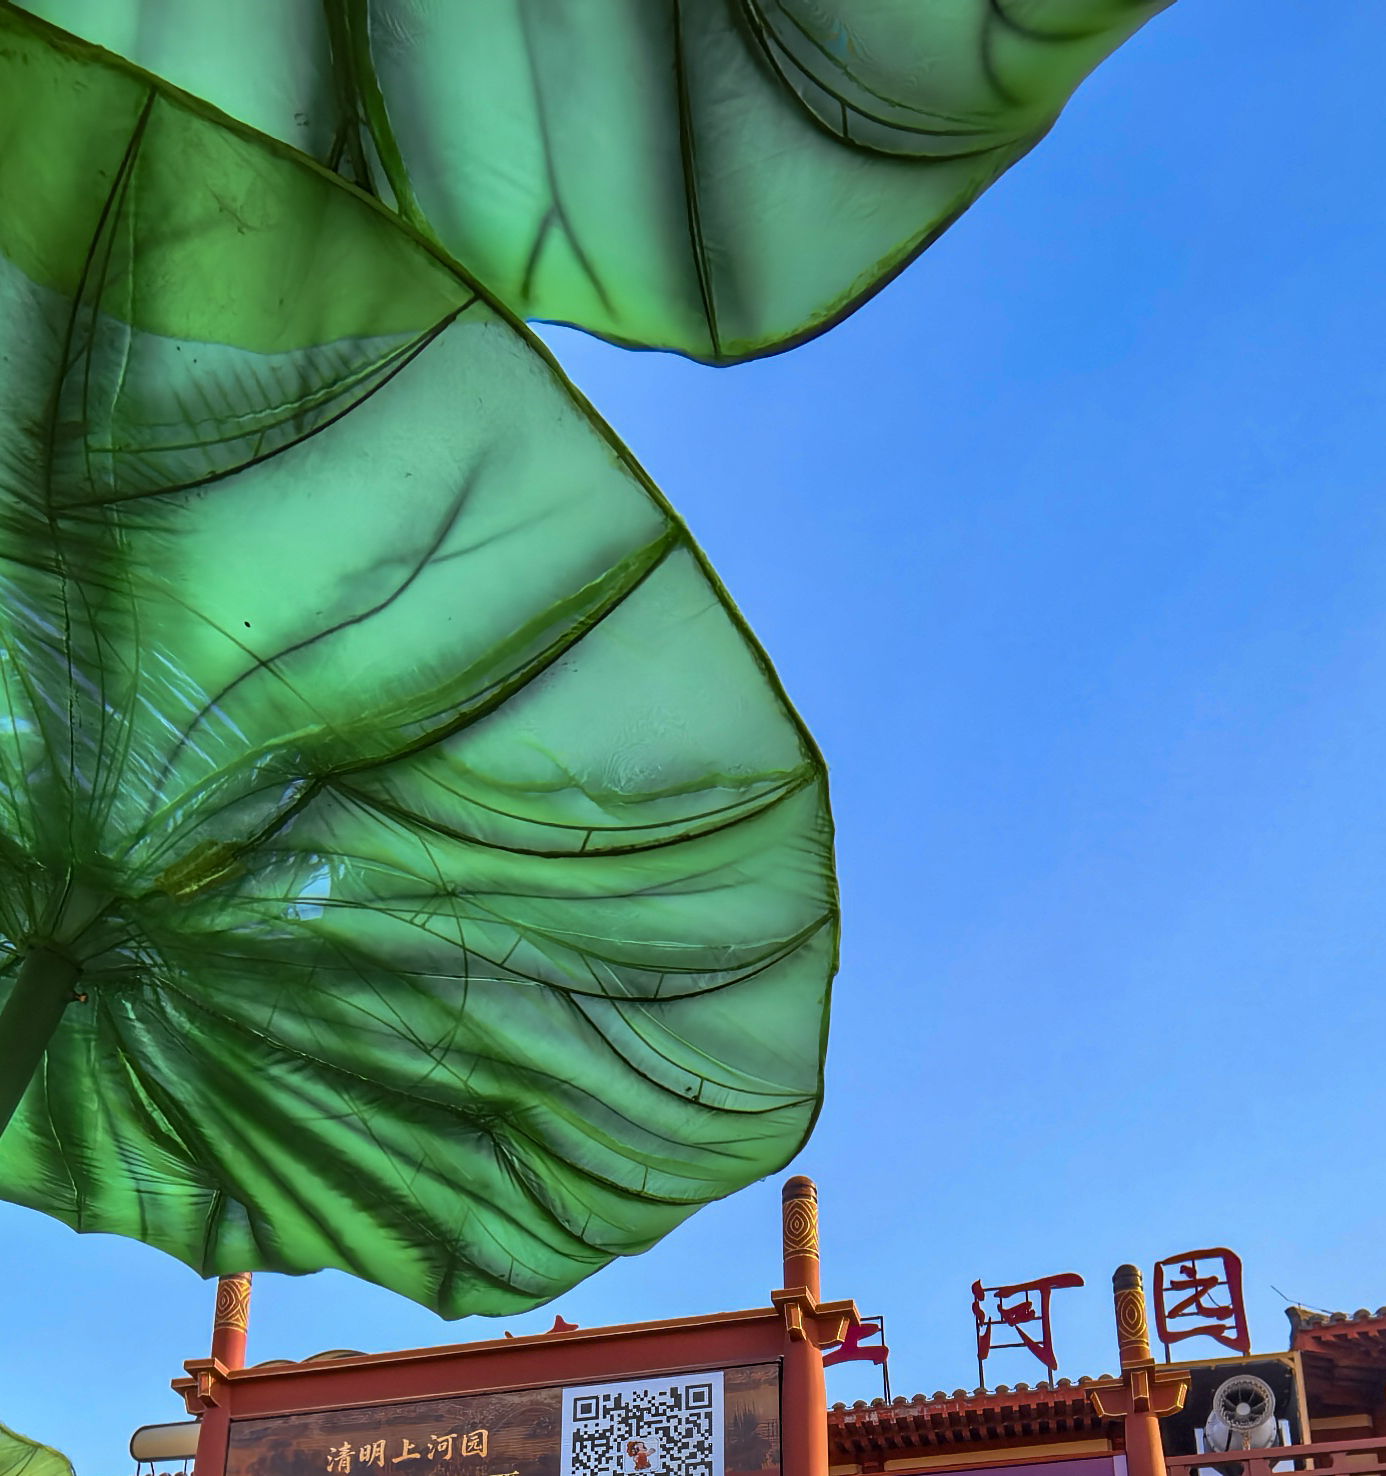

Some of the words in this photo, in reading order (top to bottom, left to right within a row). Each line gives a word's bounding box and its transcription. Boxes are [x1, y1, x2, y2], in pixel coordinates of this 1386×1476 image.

[326, 1429, 489, 1474] 清明上河园
